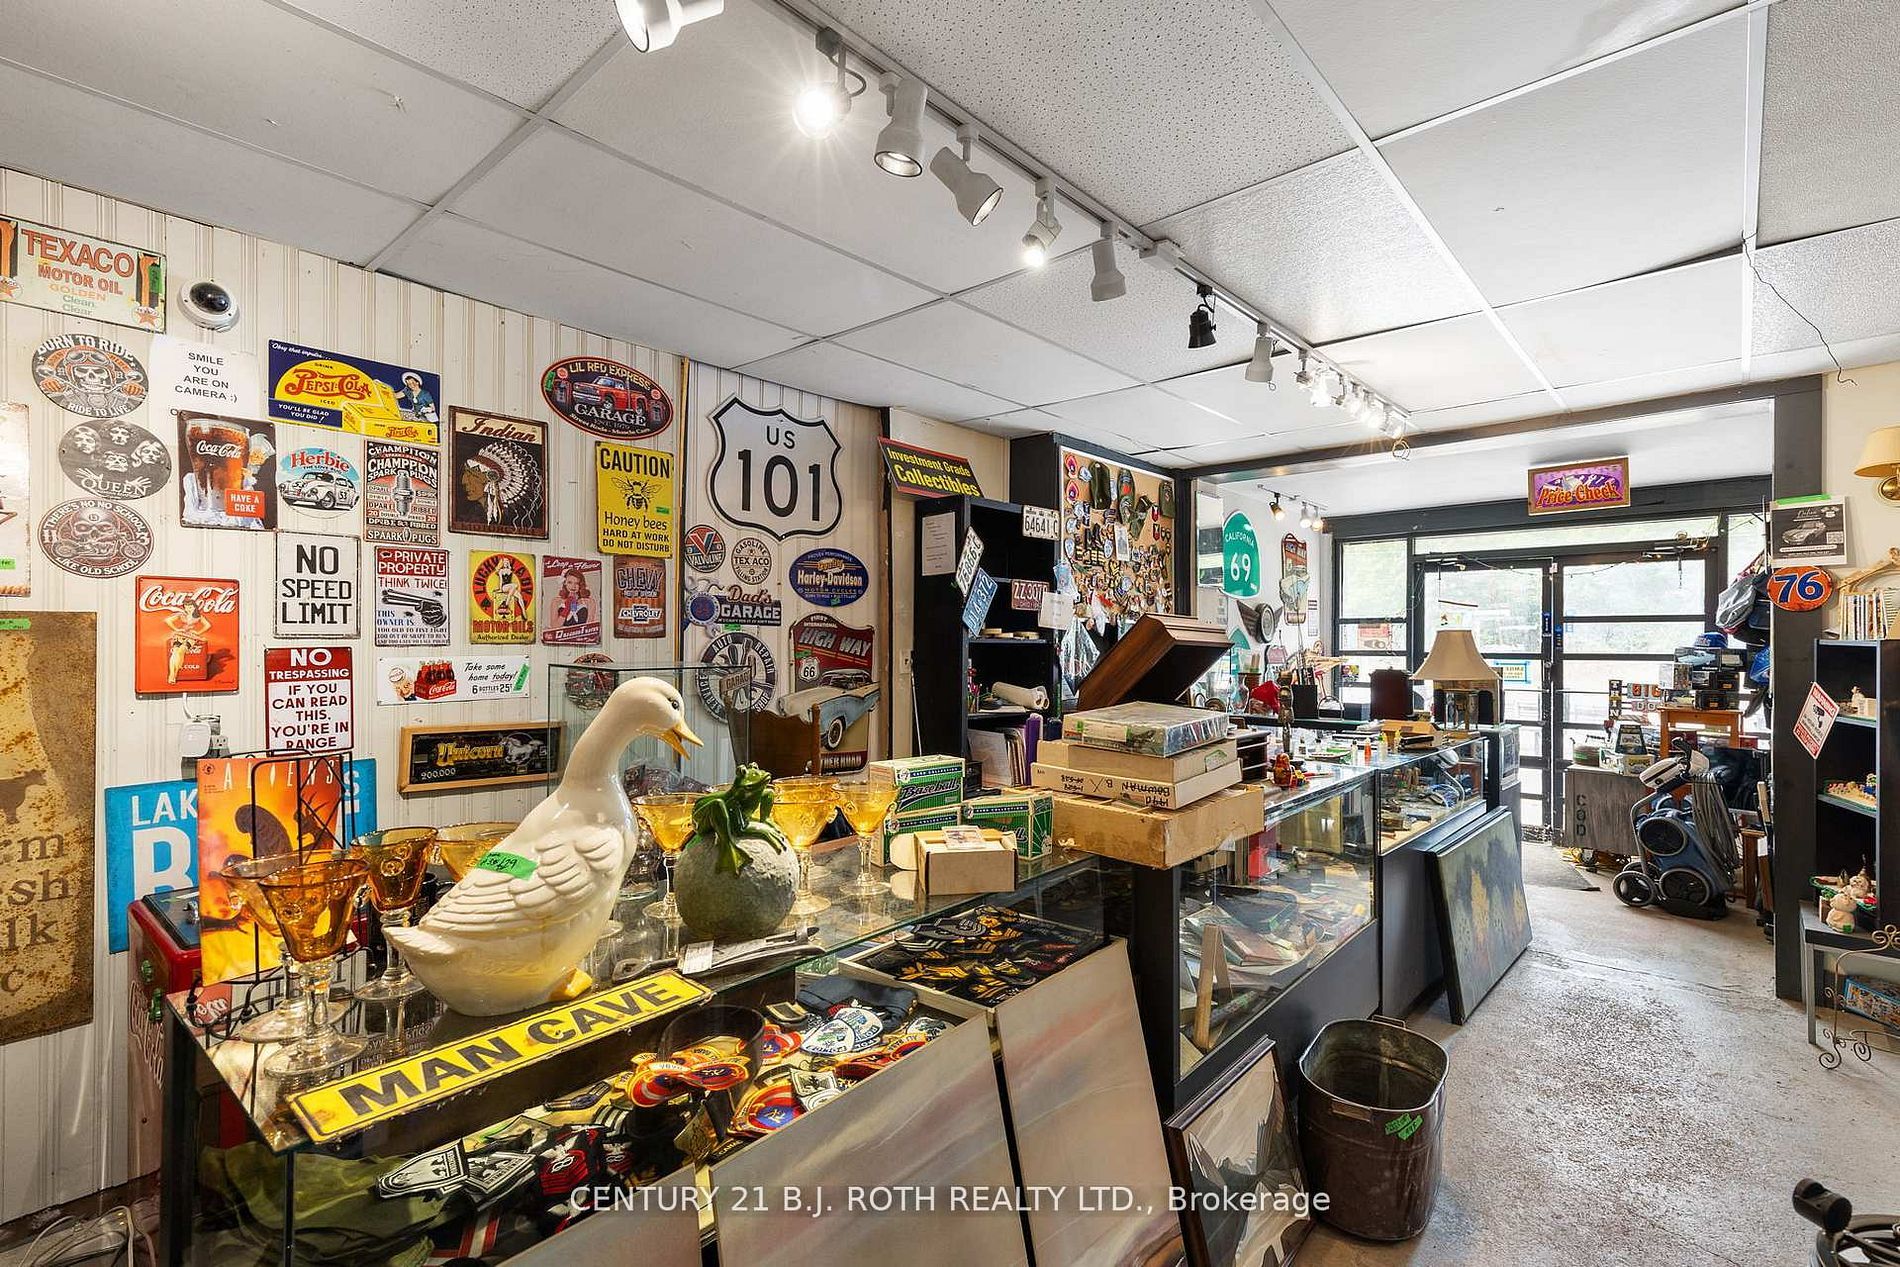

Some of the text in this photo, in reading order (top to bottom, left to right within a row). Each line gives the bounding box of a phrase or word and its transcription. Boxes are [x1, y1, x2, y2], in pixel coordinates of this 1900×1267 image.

[21, 228, 135, 278] TEXACO
[37, 264, 123, 295] MOTOR OIL
[49, 284, 107, 301] GOLDEN
[62, 294, 95, 308] Clean
[75, 335, 95, 348] TO
[99, 339, 134, 360] RIDE
[188, 353, 224, 365] SMILE
[193, 365, 218, 375] YOU
[587, 362, 607, 373] RED
[608, 365, 651, 391] EXPRESS
[184, 375, 229, 388] ARE ON
[175, 385, 227, 400] CAMERA
[110, 405, 130, 416] LIVE
[278, 403, 301, 413] YOU'LL
[312, 409, 330, 417] GLAD
[575, 404, 646, 426] GARAGE
[462, 417, 536, 442] Indian
[766, 425, 795, 449] US
[196, 440, 242, 459] Coca-Cola
[290, 452, 350, 472] Herbie
[600, 448, 670, 479] CAUTION
[887, 447, 971, 477] Investment Grade
[80, 478, 147, 497] QUEEN
[738, 449, 821, 521] 101
[894, 464, 980, 497] Collectibles
[230, 493, 252, 503] HAVE
[339, 491, 348, 500] 53
[1537, 480, 1621, 508] Price Check
[44, 500, 146, 532] THERE'S NO NO SCHOOL
[234, 504, 256, 513] COKE
[604, 511, 667, 531] Honey bees
[603, 528, 669, 542] HARD AT WORK
[1225, 531, 1255, 548] CALIFORNIA
[603, 539, 670, 552] DO NOT DISTURB
[736, 541, 768, 554] GASOLINE
[56, 556, 138, 575] LIKE OLD SCHOOL
[296, 544, 339, 575] NO
[394, 551, 445, 563] PRIVATE
[379, 562, 445, 575] PROPERTY
[735, 566, 768, 583] FILLING STATION
[1230, 552, 1252, 583] 69
[378, 577, 410, 588] THINK
[617, 567, 662, 591] CHEVY
[797, 570, 862, 587] Harley-Davidson
[1774, 571, 1825, 604] 76
[282, 579, 352, 599] SPEED
[728, 585, 772, 604] Dad's
[139, 585, 239, 614] Coca-Cola
[282, 602, 352, 624] LIMIT
[721, 604, 780, 619] GARAGE
[800, 628, 872, 656] HIGH WAY
[290, 648, 332, 667] NO
[712, 635, 775, 674] AUTO REPAIR
[269, 668, 349, 680] TRESPASSING
[464, 662, 482, 672] Take
[803, 666, 815, 678] 66
[468, 673, 489, 681] home
[289, 683, 337, 695] IF YOU
[472, 685, 478, 694] 6
[272, 695, 347, 709] CAN READ
[754, 693, 770, 712] SHOP
[271, 722, 349, 738] YOU'RE IN
[286, 737, 336, 749] RANGE
[900, 778, 960, 797] Baseball
[337, 982, 682, 1118] MAN CAVE
